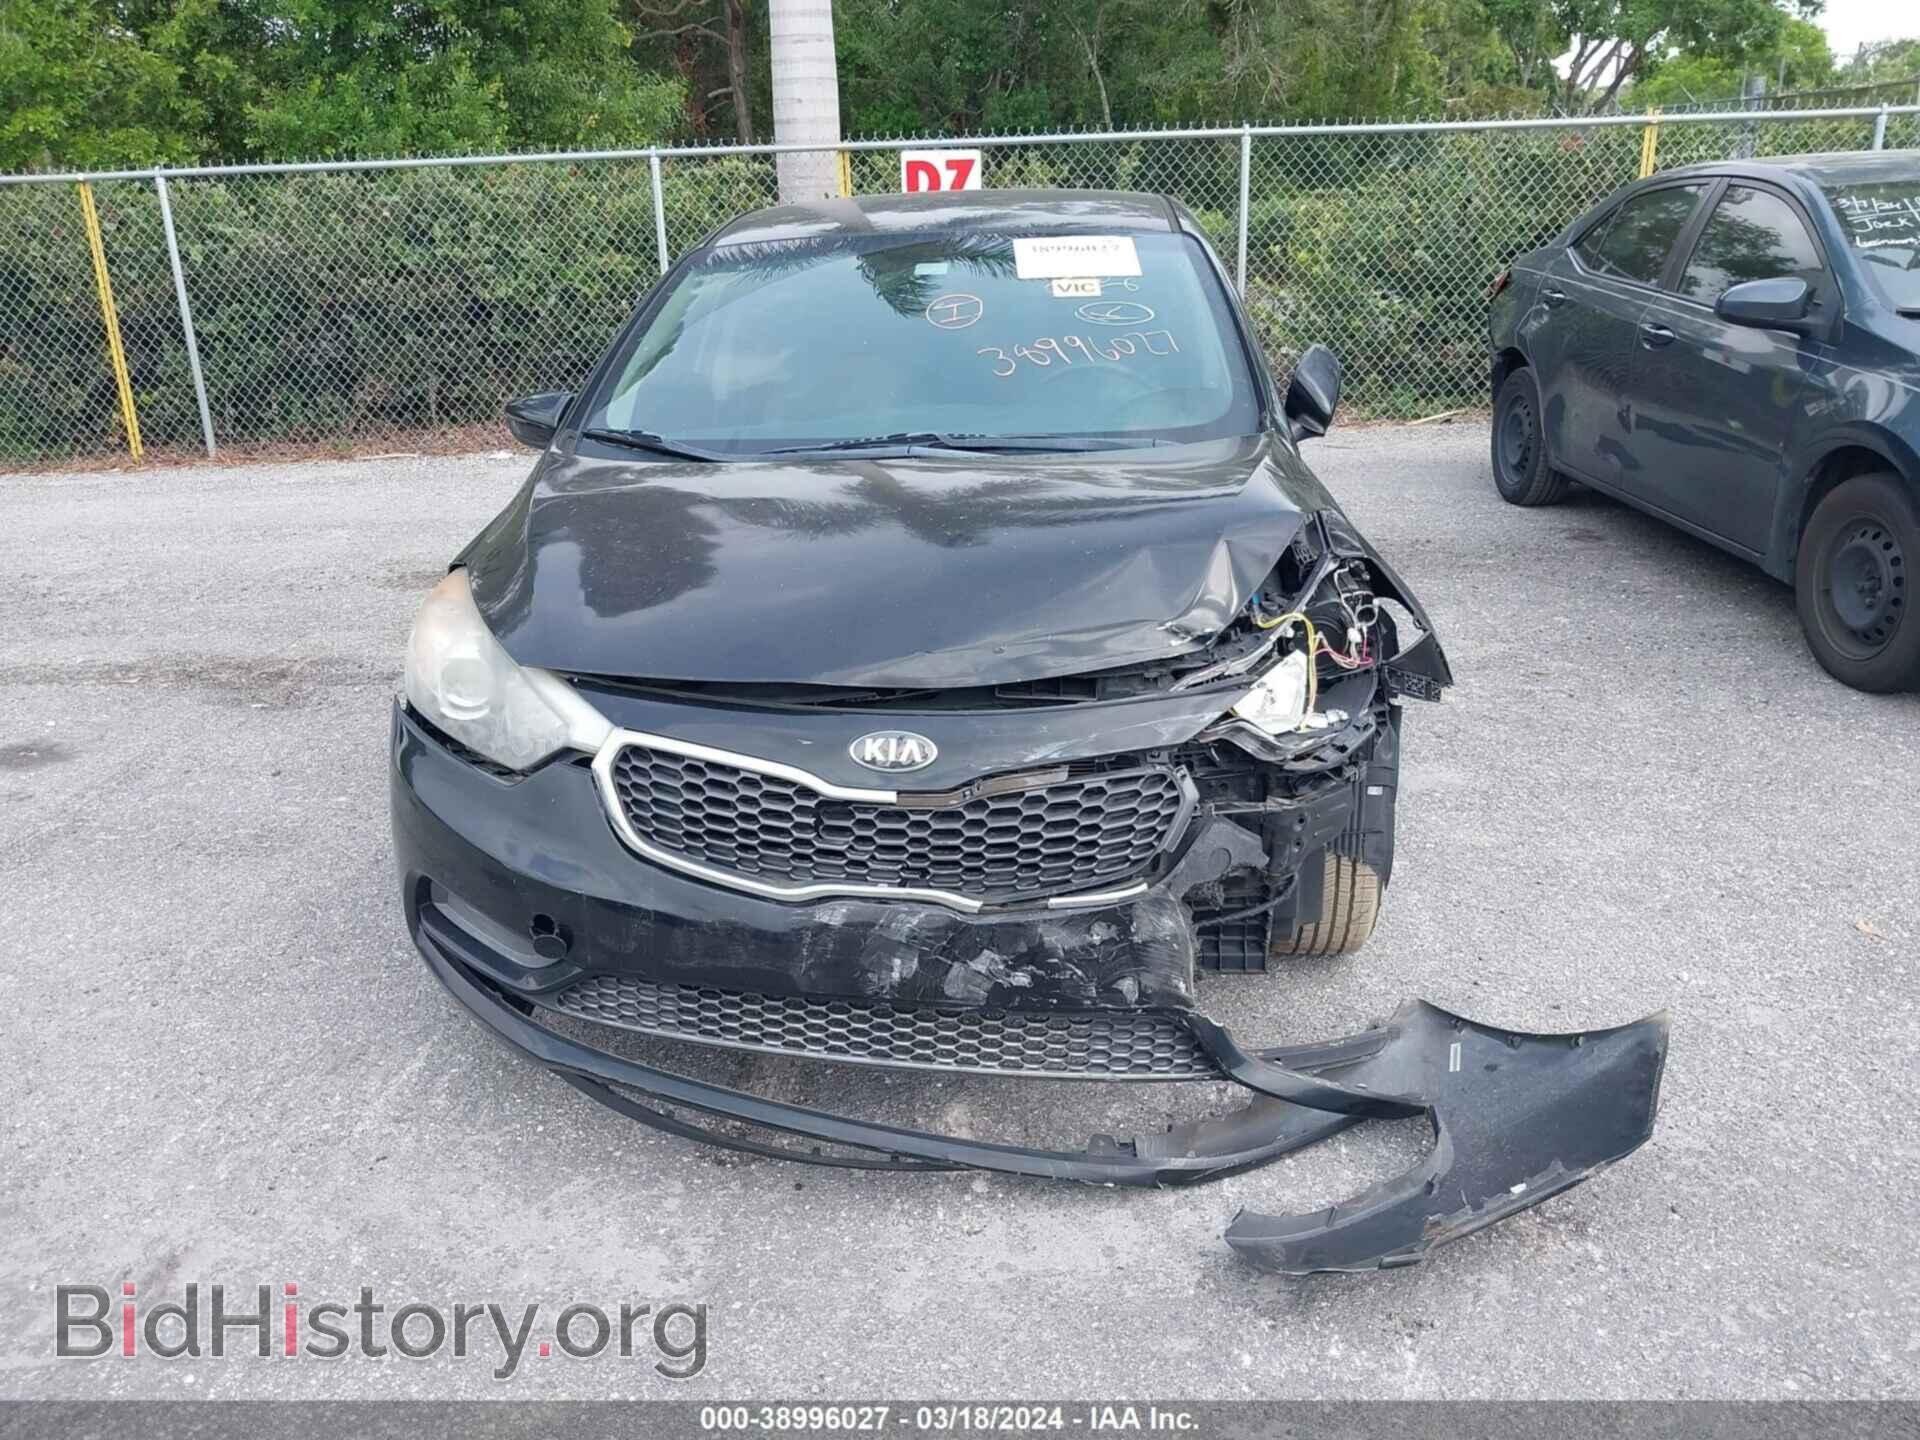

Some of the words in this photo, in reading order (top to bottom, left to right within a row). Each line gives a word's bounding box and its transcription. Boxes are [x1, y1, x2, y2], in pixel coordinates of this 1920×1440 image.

[905, 159, 976, 192] D7
[1057, 282, 1096, 293] VIC
[864, 738, 923, 762] KIA
